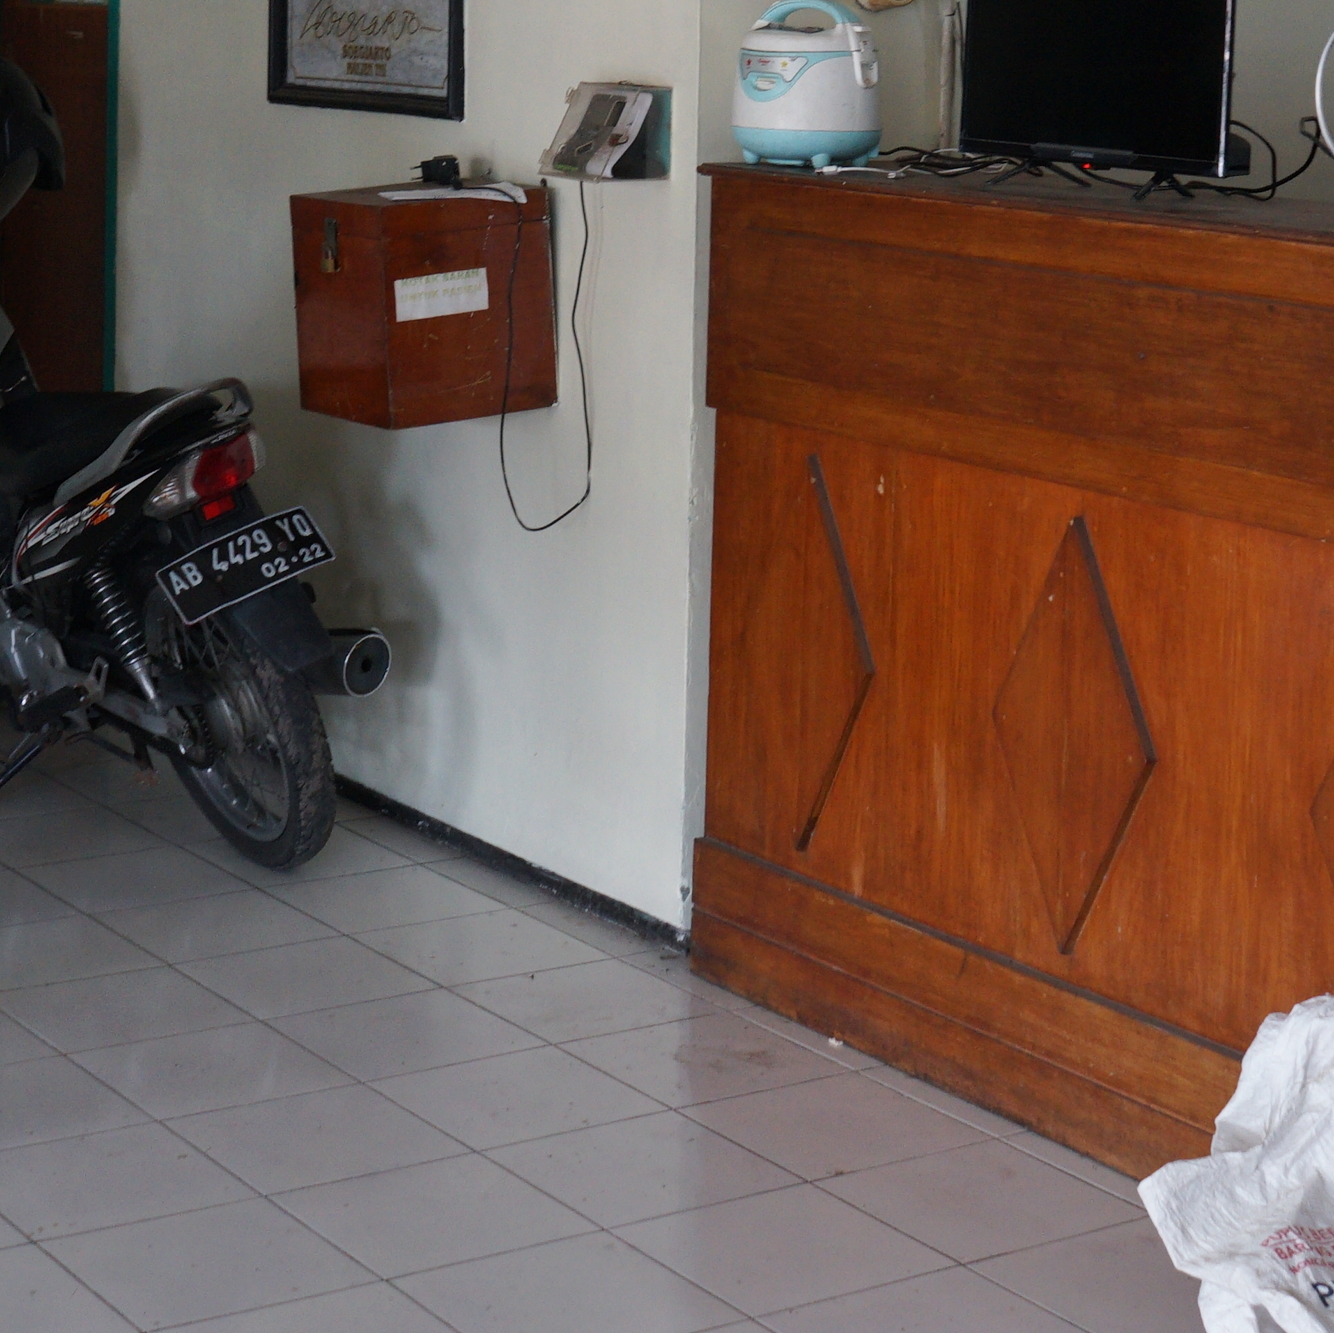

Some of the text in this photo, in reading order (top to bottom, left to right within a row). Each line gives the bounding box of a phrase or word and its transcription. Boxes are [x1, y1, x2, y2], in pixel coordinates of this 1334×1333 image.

[168, 513, 315, 596] AB 4429 YQ
